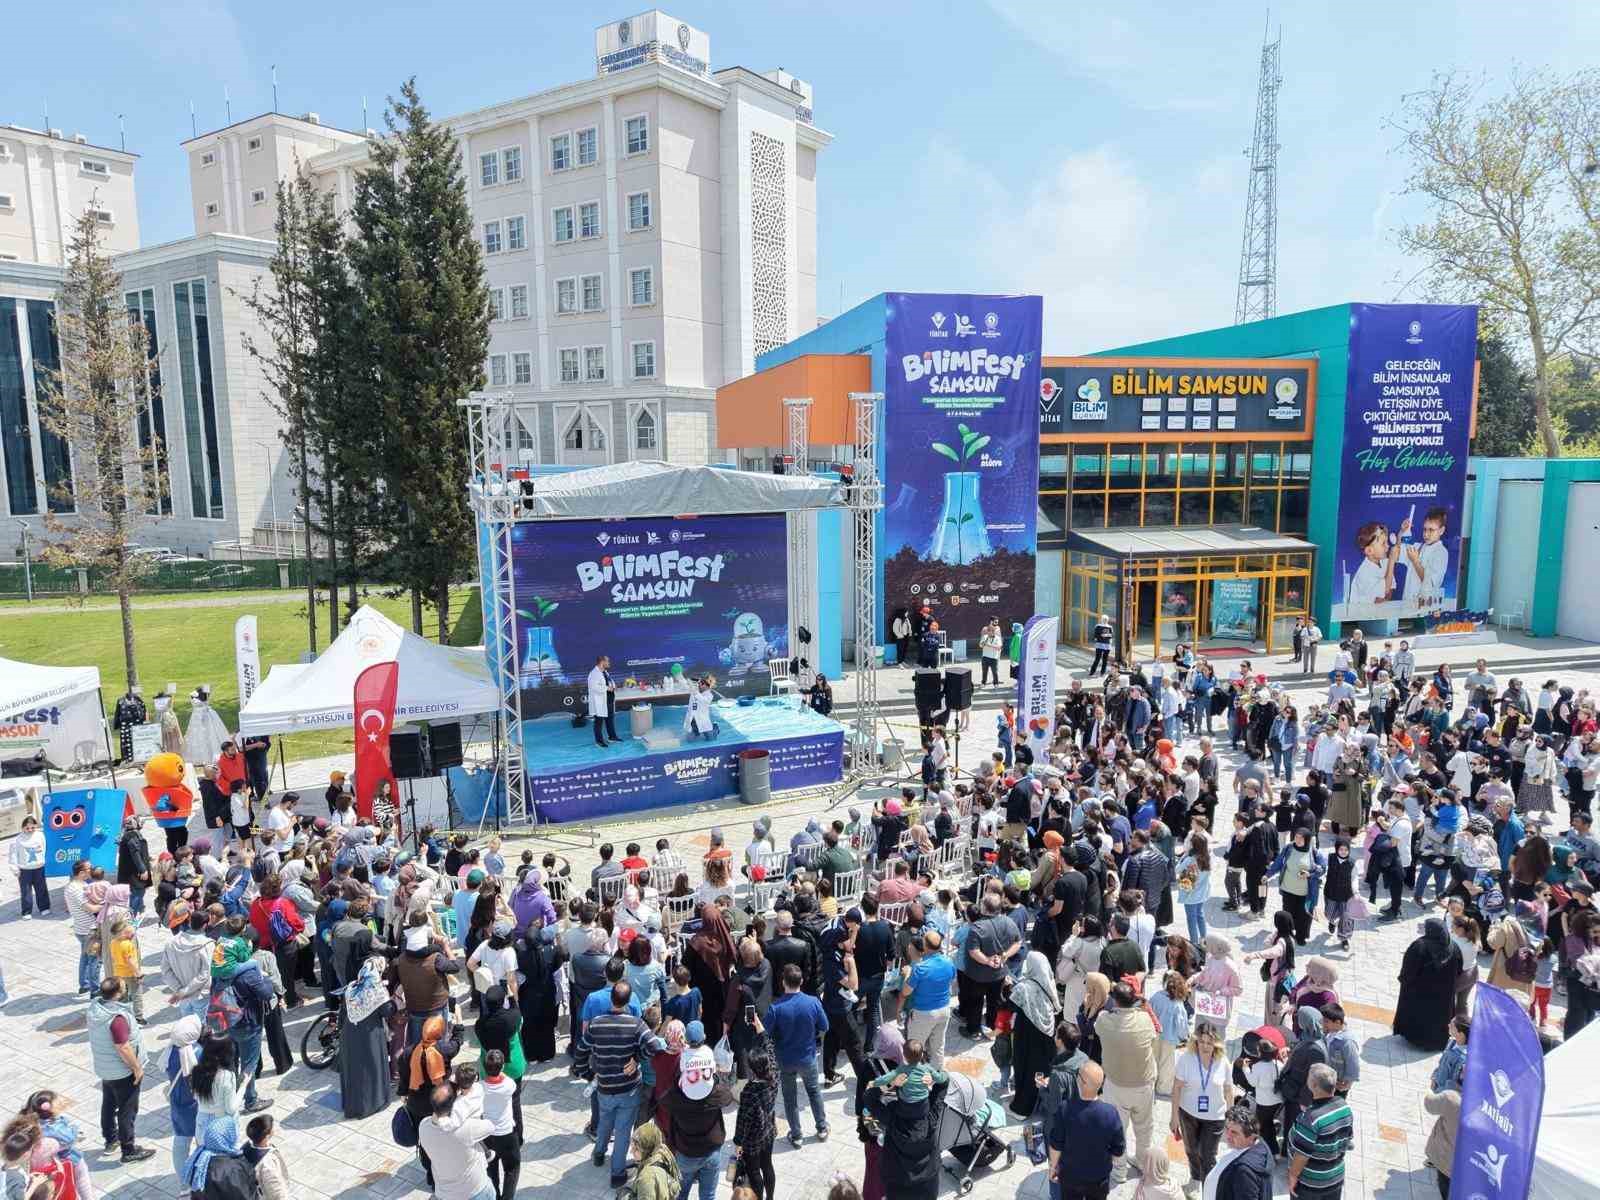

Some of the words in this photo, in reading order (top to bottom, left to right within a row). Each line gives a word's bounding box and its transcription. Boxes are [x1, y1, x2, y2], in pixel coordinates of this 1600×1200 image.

[1385, 358, 1441, 371] GELECEĞİN
[1111, 368, 1174, 395] BİLİM
[1178, 375, 1268, 395] SAMSUN
[1373, 371, 1399, 383] BİLİM
[1401, 371, 1451, 383] İNSANLARI
[929, 375, 999, 394] SAMSUN
[1383, 385, 1440, 396] SAMSUN'DA
[1378, 397, 1419, 411] YETİŞSİN
[1421, 397, 1443, 409] DİYE
[1363, 409, 1416, 424] ÇIKTIĞIMIZ
[1419, 411, 1452, 422] YOLDA,
[1371, 436, 1443, 449] BULUŞUYORUZ!
[1356, 447, 1390, 472] Hoş
[1393, 445, 1455, 471] Geldiniz
[1402, 483, 1438, 493] DOĞAN
[611, 578, 695, 603] SAMSUN
[304, 712, 345, 724] SAMSUN
